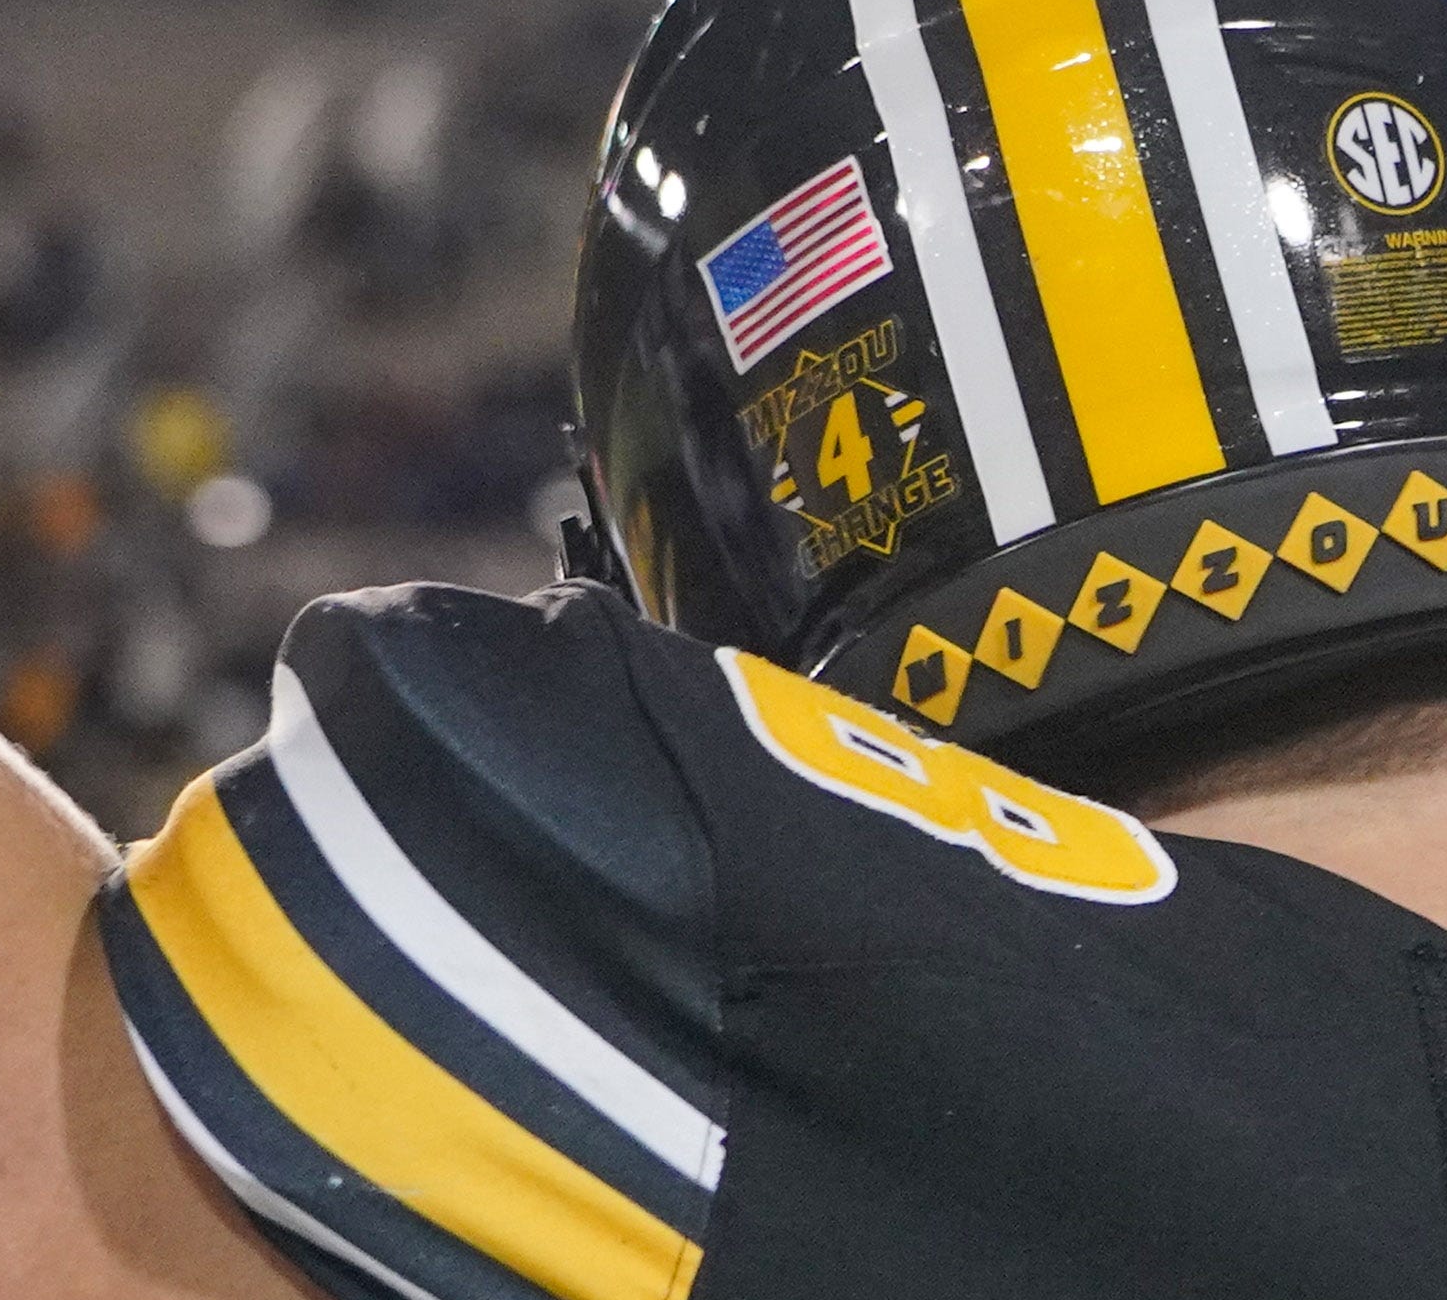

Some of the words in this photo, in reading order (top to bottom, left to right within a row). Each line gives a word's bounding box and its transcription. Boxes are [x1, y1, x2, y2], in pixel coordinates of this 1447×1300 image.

[1336, 101, 1437, 206] SEC
[736, 318, 899, 450] MIZZOU
[816, 390, 874, 503] 4
[797, 454, 955, 580] CHANGE
